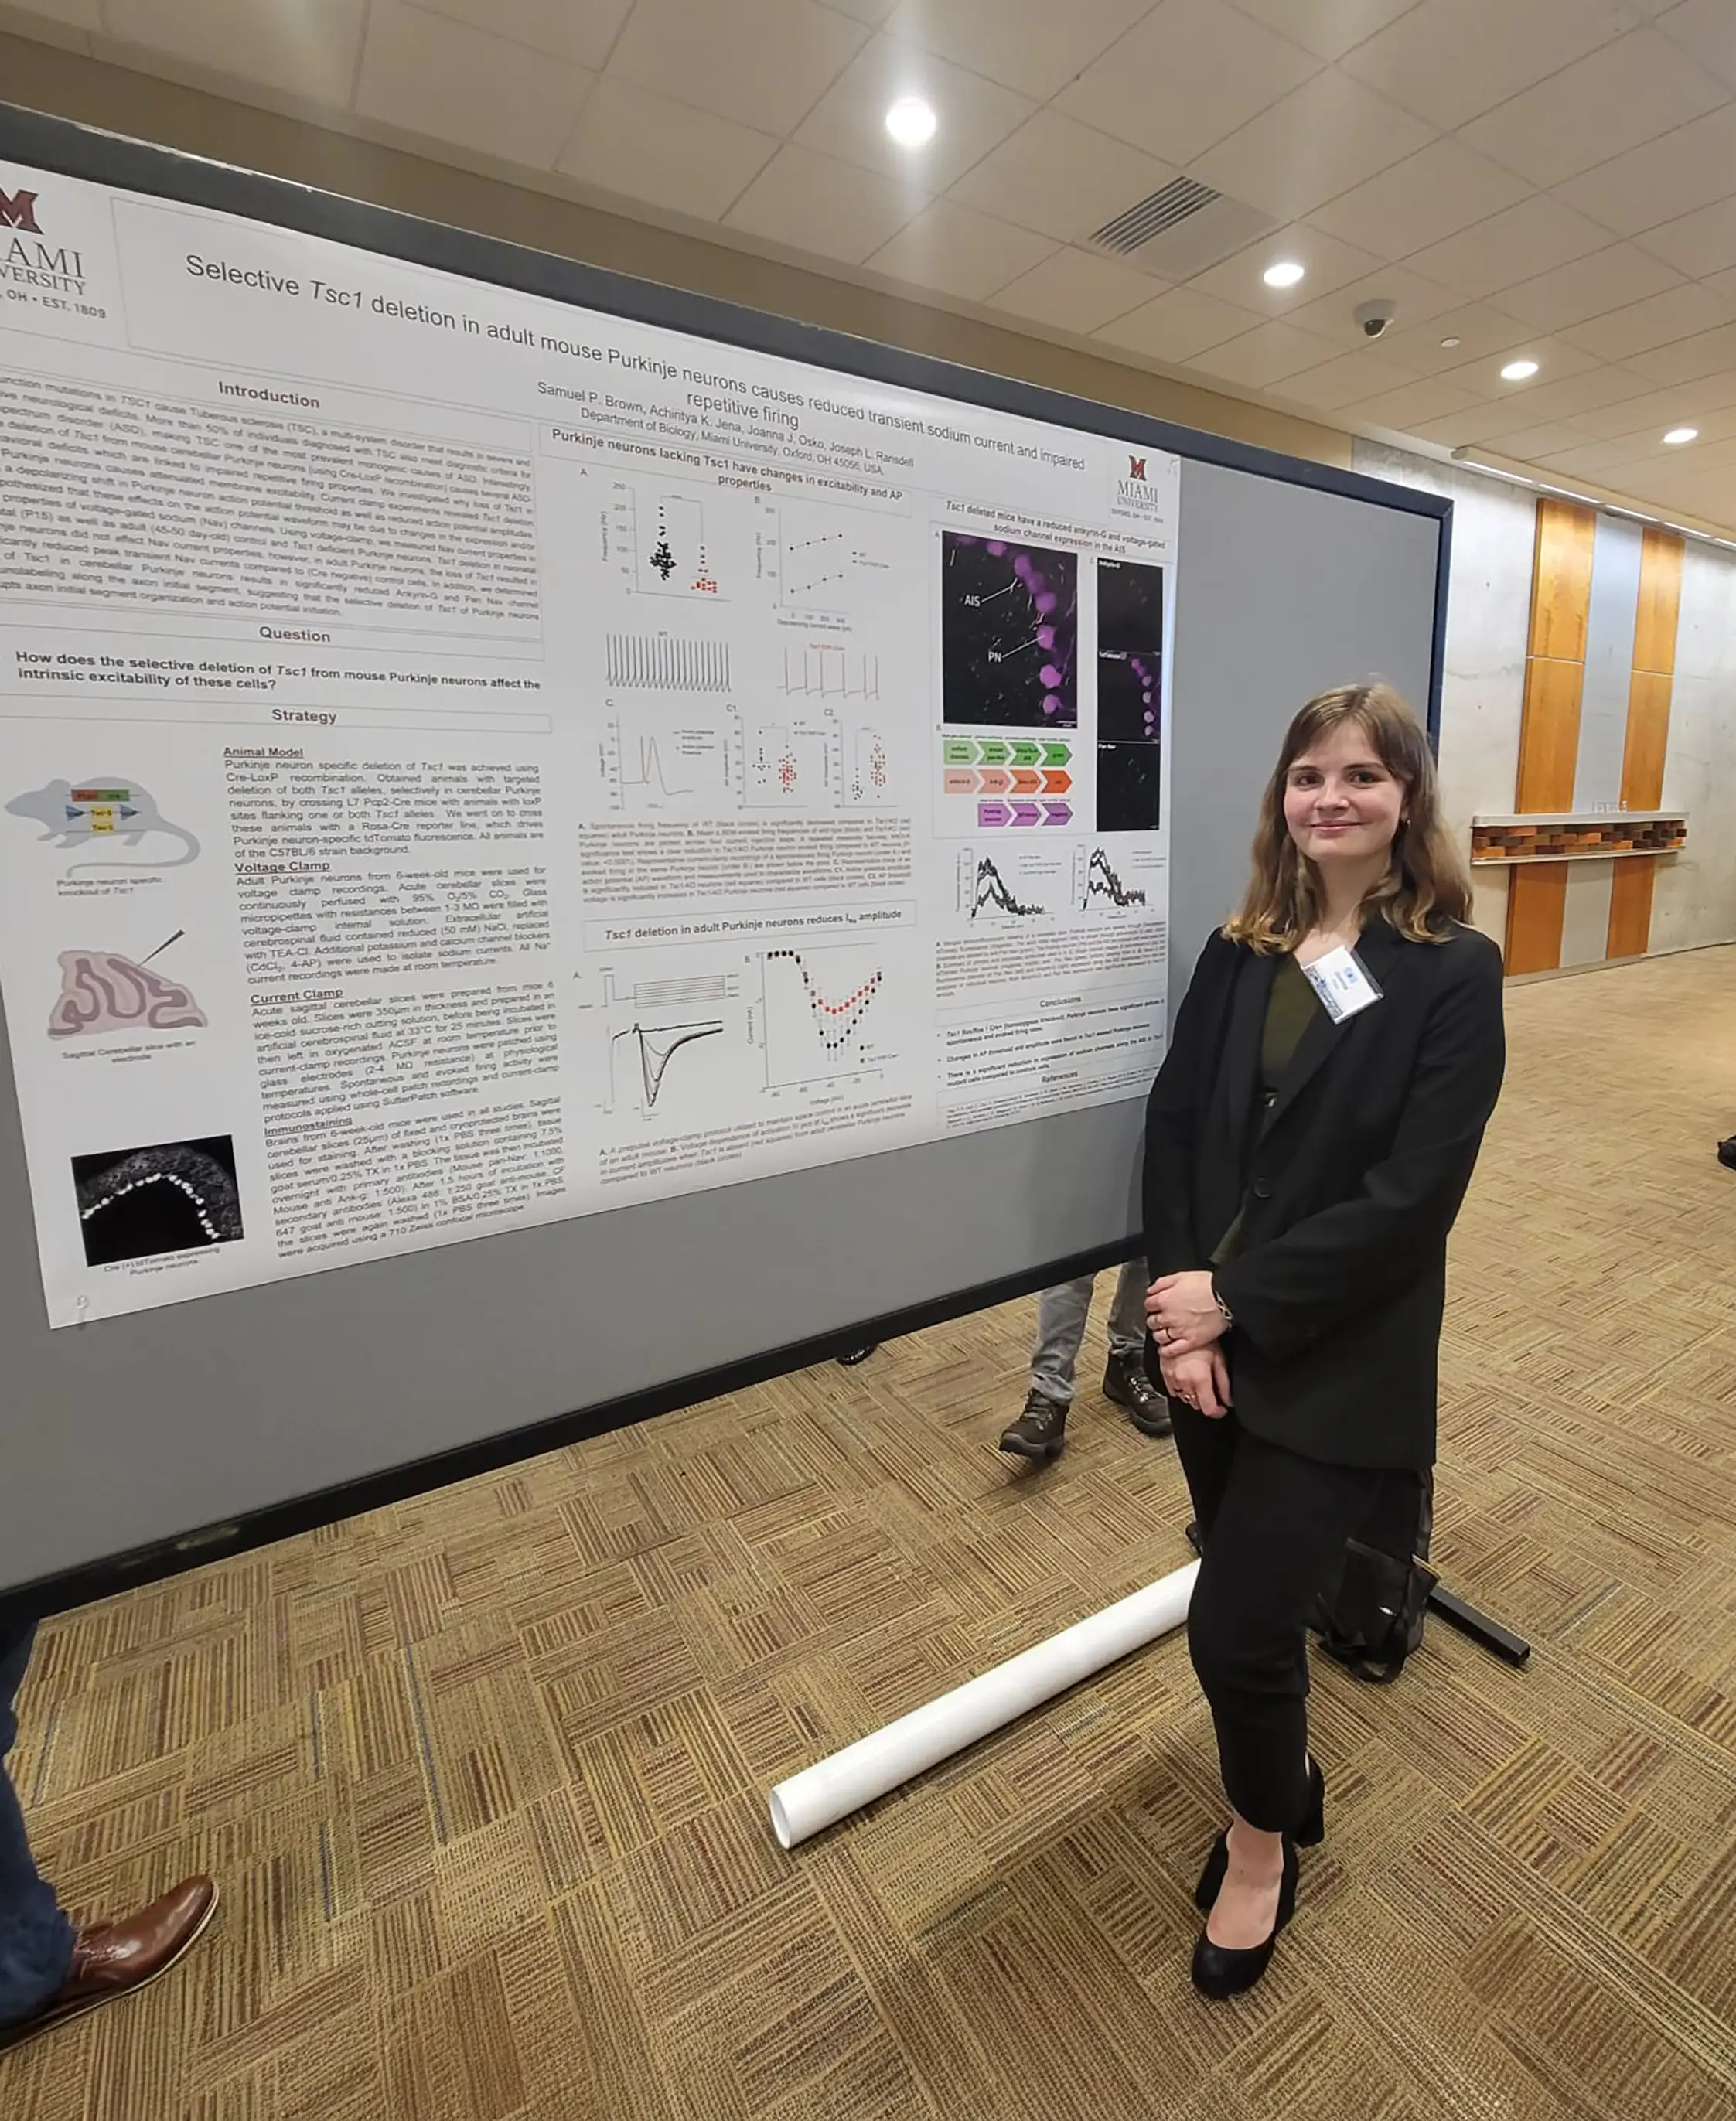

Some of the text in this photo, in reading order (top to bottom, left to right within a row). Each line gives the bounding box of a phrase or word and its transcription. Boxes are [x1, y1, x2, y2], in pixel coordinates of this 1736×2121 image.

[0, 237, 86, 278] AMI
[7, 289, 27, 302] OH
[187, 255, 1084, 469] Selective Tsc1 deletion in adult mouse Purkinje neurons causes reduced transient sodium current and impaired
[219, 381, 319, 409] Introduction
[538, 382, 585, 402] Samuel
[605, 395, 646, 415] Brown,
[650, 405, 697, 425] Achintya
[715, 418, 744, 434] Jena,
[747, 425, 784, 442] Joanna
[798, 435, 827, 451] Osko,
[830, 442, 863, 457] Joseph
[687, 393, 798, 431] repetitive firing
[553, 428, 902, 500] Purkinje neurons lacking Tsc1 have changes in excitability and AP
[718, 476, 772, 492] properties
[1117, 479, 1158, 503] MIAMI
[965, 595, 980, 607] AIS
[259, 626, 331, 643] Question
[988, 650, 1001, 663] PN
[15, 651, 541, 689] How does the selective deletion of Tsc1 from mouse Purkinje neurons affect the
[19, 668, 276, 690] intrinsic excitability of these cells?
[272, 709, 337, 725] Strategy
[223, 746, 305, 758] Animal Model
[234, 861, 331, 874] Voltage Clamp
[605, 929, 631, 939] Tsc1
[635, 926, 678, 938] deletion
[680, 925, 691, 934] in
[694, 923, 720, 933] adult
[722, 919, 762, 931] Purkinje
[766, 919, 804, 927] neurons
[807, 916, 843, 924] reduces
[858, 910, 902, 921] amplitude
[251, 989, 344, 1004] Current Clamp
[264, 1117, 353, 1136] Immunostaining
